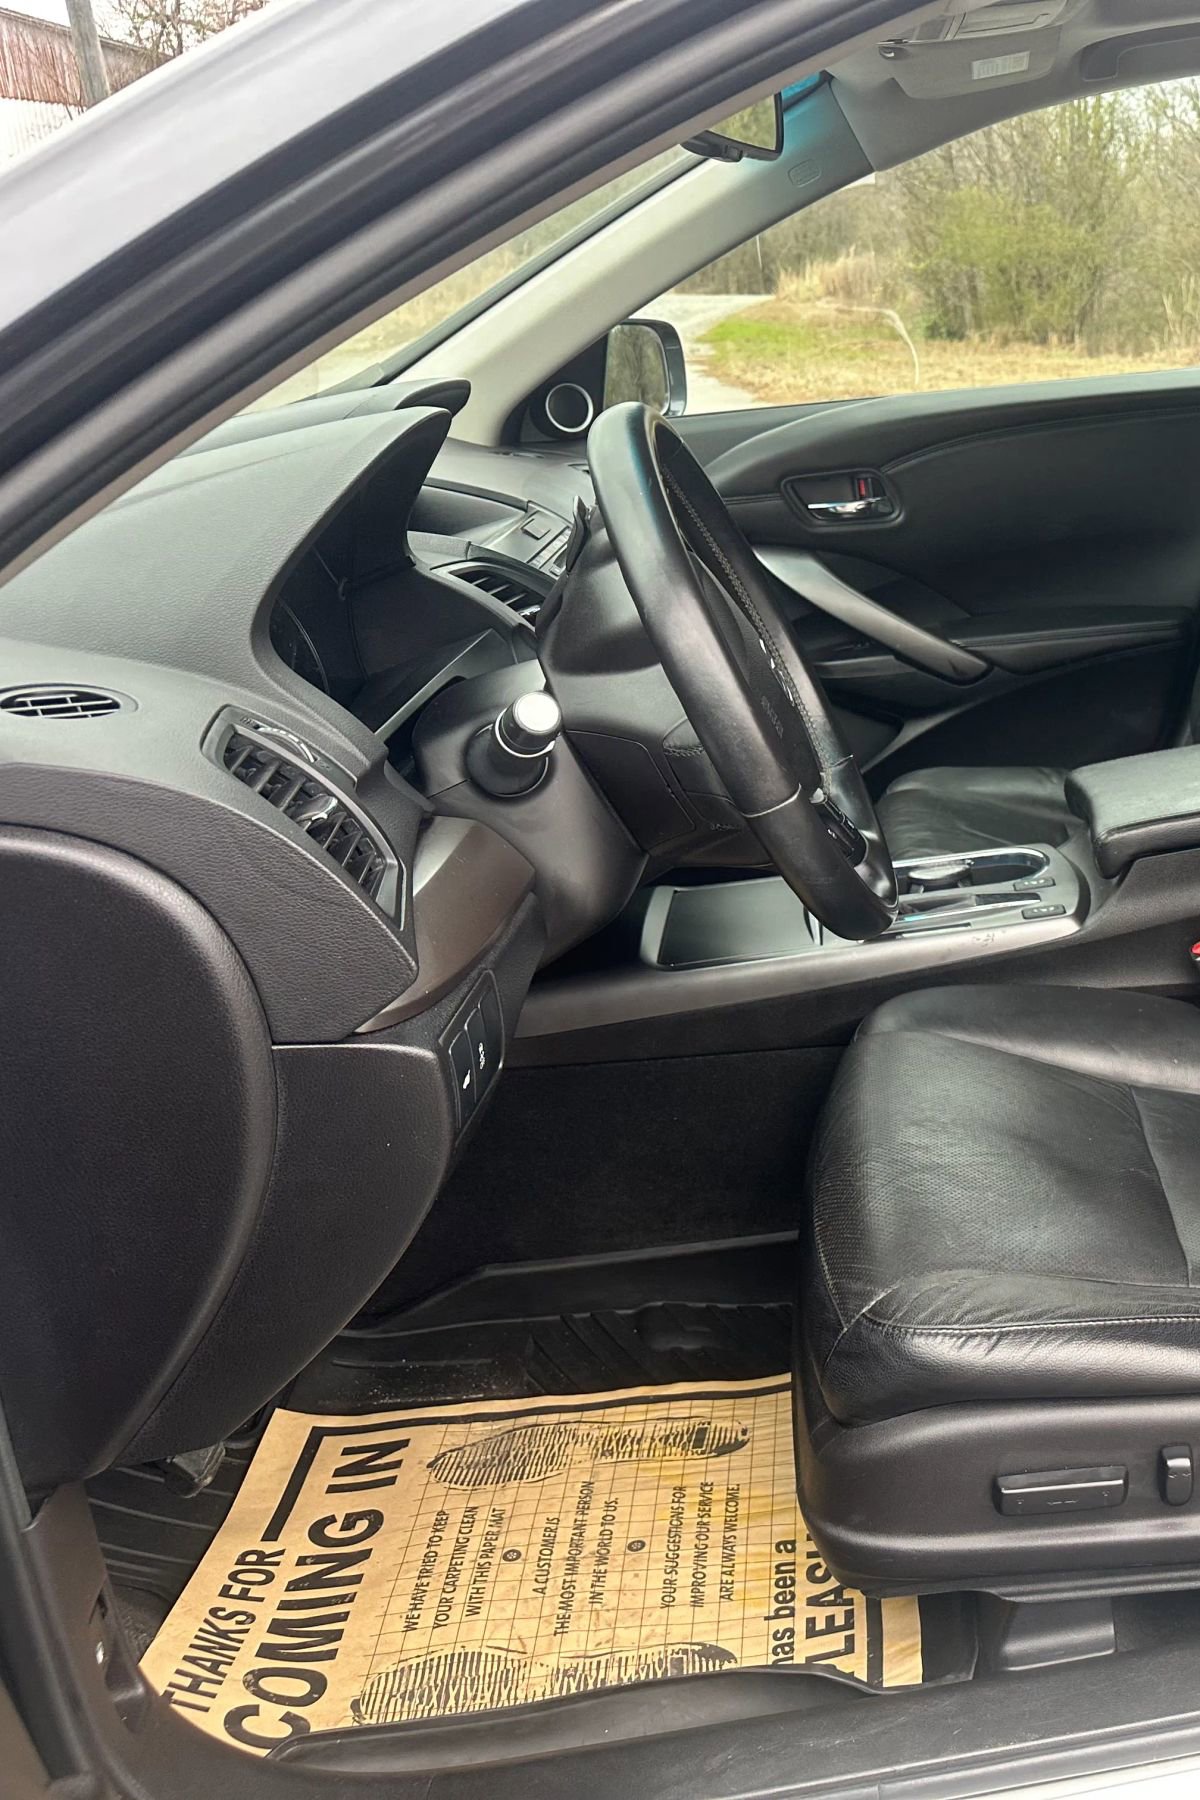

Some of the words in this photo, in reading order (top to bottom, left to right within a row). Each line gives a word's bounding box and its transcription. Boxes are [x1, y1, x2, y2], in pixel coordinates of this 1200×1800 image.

[576, 1481, 595, 1516] PERSON
[604, 1497, 618, 1514] US.
[672, 1486, 686, 1504] FOR
[697, 1481, 714, 1518] SERVICE
[724, 1483, 740, 1535] WELCOME.
[432, 1510, 450, 1535] KEEP
[458, 1506, 479, 1536] CLEAN
[489, 1508, 506, 1531] MAT
[546, 1516, 560, 1526] IS
[601, 1514, 616, 1528] TO
[695, 1521, 711, 1542] OUR
[426, 1535, 442, 1550] TO
[479, 1530, 499, 1562] PAPER
[534, 1526, 559, 1585] CUSTOMER
[564, 1518, 587, 1576] IMPORTANT
[594, 1528, 613, 1567] WORLD
[664, 1505, 685, 1575] SUGGESTIONS
[775, 1539, 796, 1553] a
[417, 1550, 438, 1582] TRIED
[442, 1536, 470, 1594] CARPETING
[721, 1535, 737, 1577] ALWAYS
[473, 1562, 492, 1586] THIS
[590, 1568, 607, 1591] THE
[690, 1544, 708, 1608] IMPROVING
[223, 1508, 385, 1750] COMING
[325, 1438, 411, 1495] IN
[408, 1581, 430, 1611] HAVE
[466, 1586, 486, 1617] WITH
[532, 1586, 547, 1595] A
[558, 1579, 576, 1613] MOST
[588, 1591, 604, 1604] IN
[660, 1578, 677, 1609] YOUR
[720, 1579, 734, 1601] ARE
[764, 1562, 796, 1621] been
[401, 1613, 421, 1632] WE
[433, 1596, 455, 1630] YOUR
[553, 1613, 571, 1636] THE
[160, 1606, 256, 1712] THANKS
[218, 1549, 286, 1602] FOR
